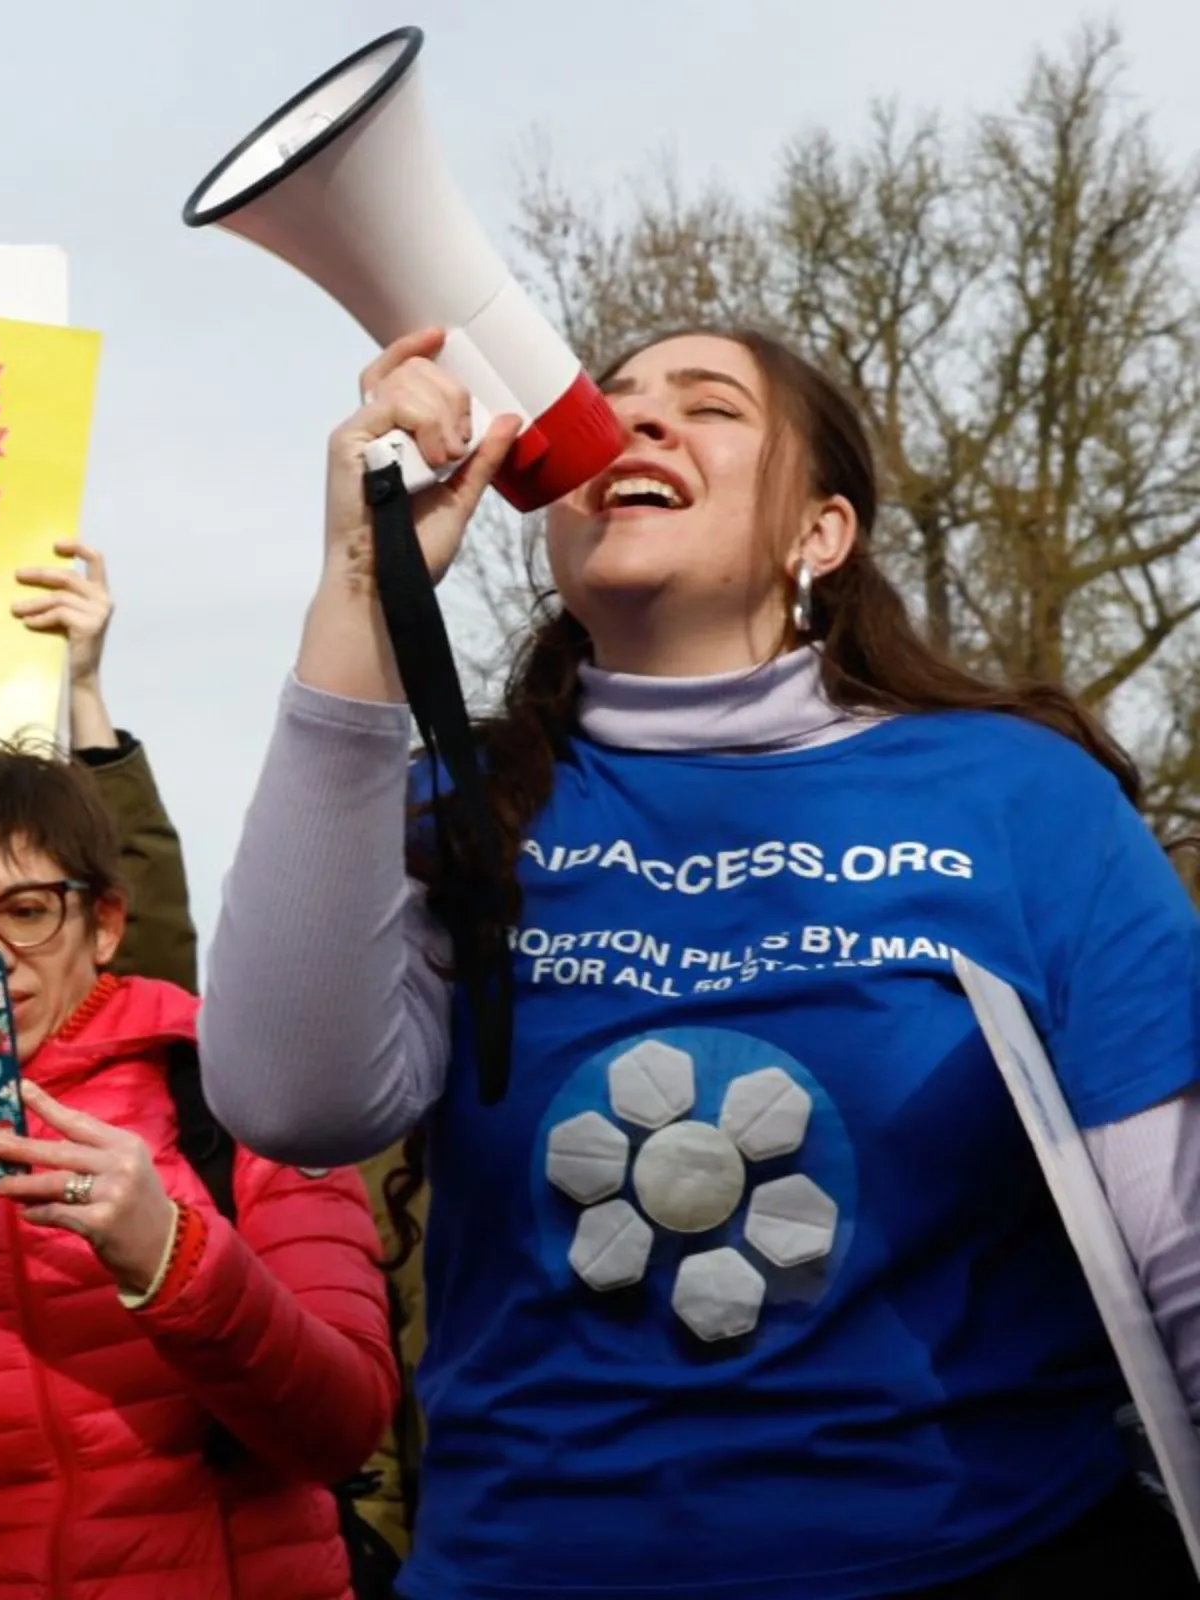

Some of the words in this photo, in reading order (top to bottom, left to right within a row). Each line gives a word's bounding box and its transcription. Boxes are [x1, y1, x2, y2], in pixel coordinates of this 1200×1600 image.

[801, 925, 860, 959] BY
[532, 957, 606, 985] FOR
[612, 966, 682, 998] ALL
